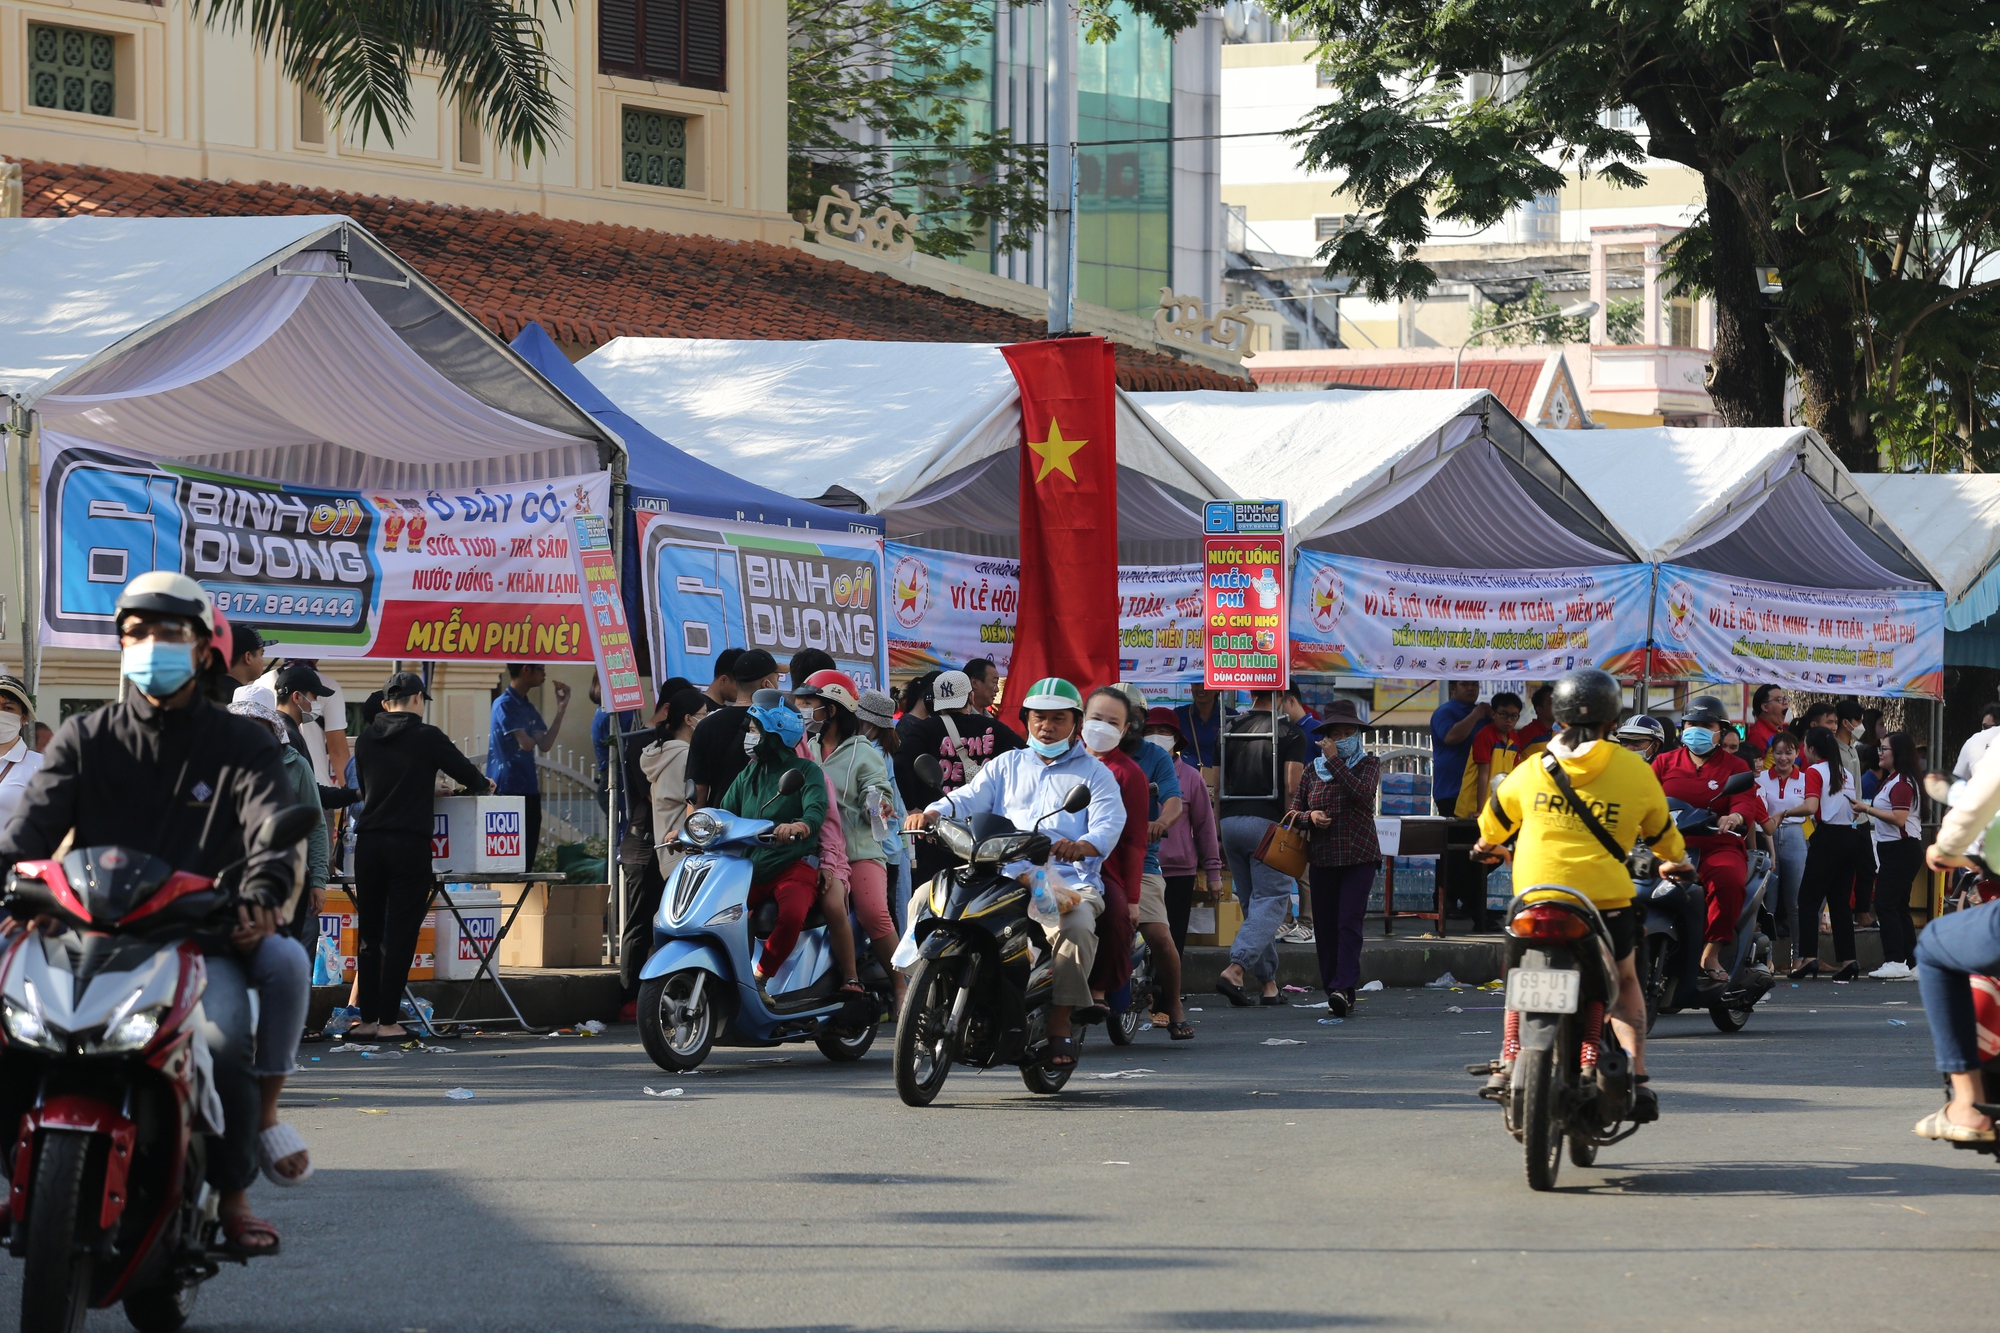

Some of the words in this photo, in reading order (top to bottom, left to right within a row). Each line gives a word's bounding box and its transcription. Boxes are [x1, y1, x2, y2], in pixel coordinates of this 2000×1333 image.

[188, 482, 308, 533] BINH
[308, 499, 363, 536] oil
[1236, 504, 1264, 513] BINH
[1236, 513, 1279, 522] DUONG
[193, 529, 367, 583] DUONG
[426, 533, 461, 557] SỮA
[460, 537, 497, 557] TƯƠI
[537, 535, 568, 558] SÂM
[1208, 546, 1243, 564] NƯỚC
[1245, 544, 1280, 564] UỐNG
[412, 566, 452, 591] NƯỚC
[455, 565, 494, 592] UỐNG
[506, 569, 544, 593] KHĂN
[745, 554, 833, 605] BINH
[833, 566, 872, 610] oil
[1187, 567, 1204, 586] MỘ
[1210, 567, 1251, 588] MIỄN
[950, 581, 968, 609] VÌ
[970, 578, 988, 611] LỄ
[992, 584, 1017, 618] HỘI
[1127, 592, 1165, 617] TOÀN
[1216, 588, 1245, 608] PHÍ
[1364, 590, 1378, 616] VÌ
[1381, 587, 1398, 617] LỄ
[1399, 592, 1422, 622] HỘI
[1425, 594, 1452, 619] VĂN
[1455, 600, 1487, 620] MINH
[1499, 601, 1517, 621] AN
[1520, 597, 1555, 621] TOÀN
[1565, 593, 1593, 622] MIỄN
[1595, 597, 1616, 621] PHÍ
[406, 606, 481, 653] MIỄN
[483, 614, 532, 654] PHÍ
[534, 615, 581, 655] NÈ!
[751, 602, 875, 657] DUONG
[1210, 612, 1226, 627] CÔ
[1709, 603, 1721, 627] VÌ
[1723, 601, 1736, 629] LỄ
[1739, 607, 1757, 635] HỘI
[1759, 609, 1780, 633] VĂN
[1782, 614, 1808, 635] MINH
[1818, 618, 1833, 638] AN
[1836, 616, 1864, 640] TOÀN
[1873, 616, 1897, 643] MIỄN
[1899, 620, 1916, 644] PHÍ
[1122, 623, 1154, 648] UỐNG
[1212, 631, 1229, 650] BỎ
[1417, 627, 1447, 650] NHẬN
[1447, 627, 1471, 648] THỨC
[1470, 628, 1487, 649] ĂN
[1491, 629, 1517, 649] NƯỚC
[1517, 627, 1544, 650] UỐNG
[1239, 651, 1278, 668] THÙNG
[1213, 671, 1232, 682] DÙM
[1234, 674, 1253, 682] CON
[1254, 673, 1277, 682] NHA!
[1533, 792, 1621, 824] PRICE
[486, 813, 518, 834] LIQUI
[487, 835, 519, 855] MOLY
[1518, 991, 1567, 1009] 4043
